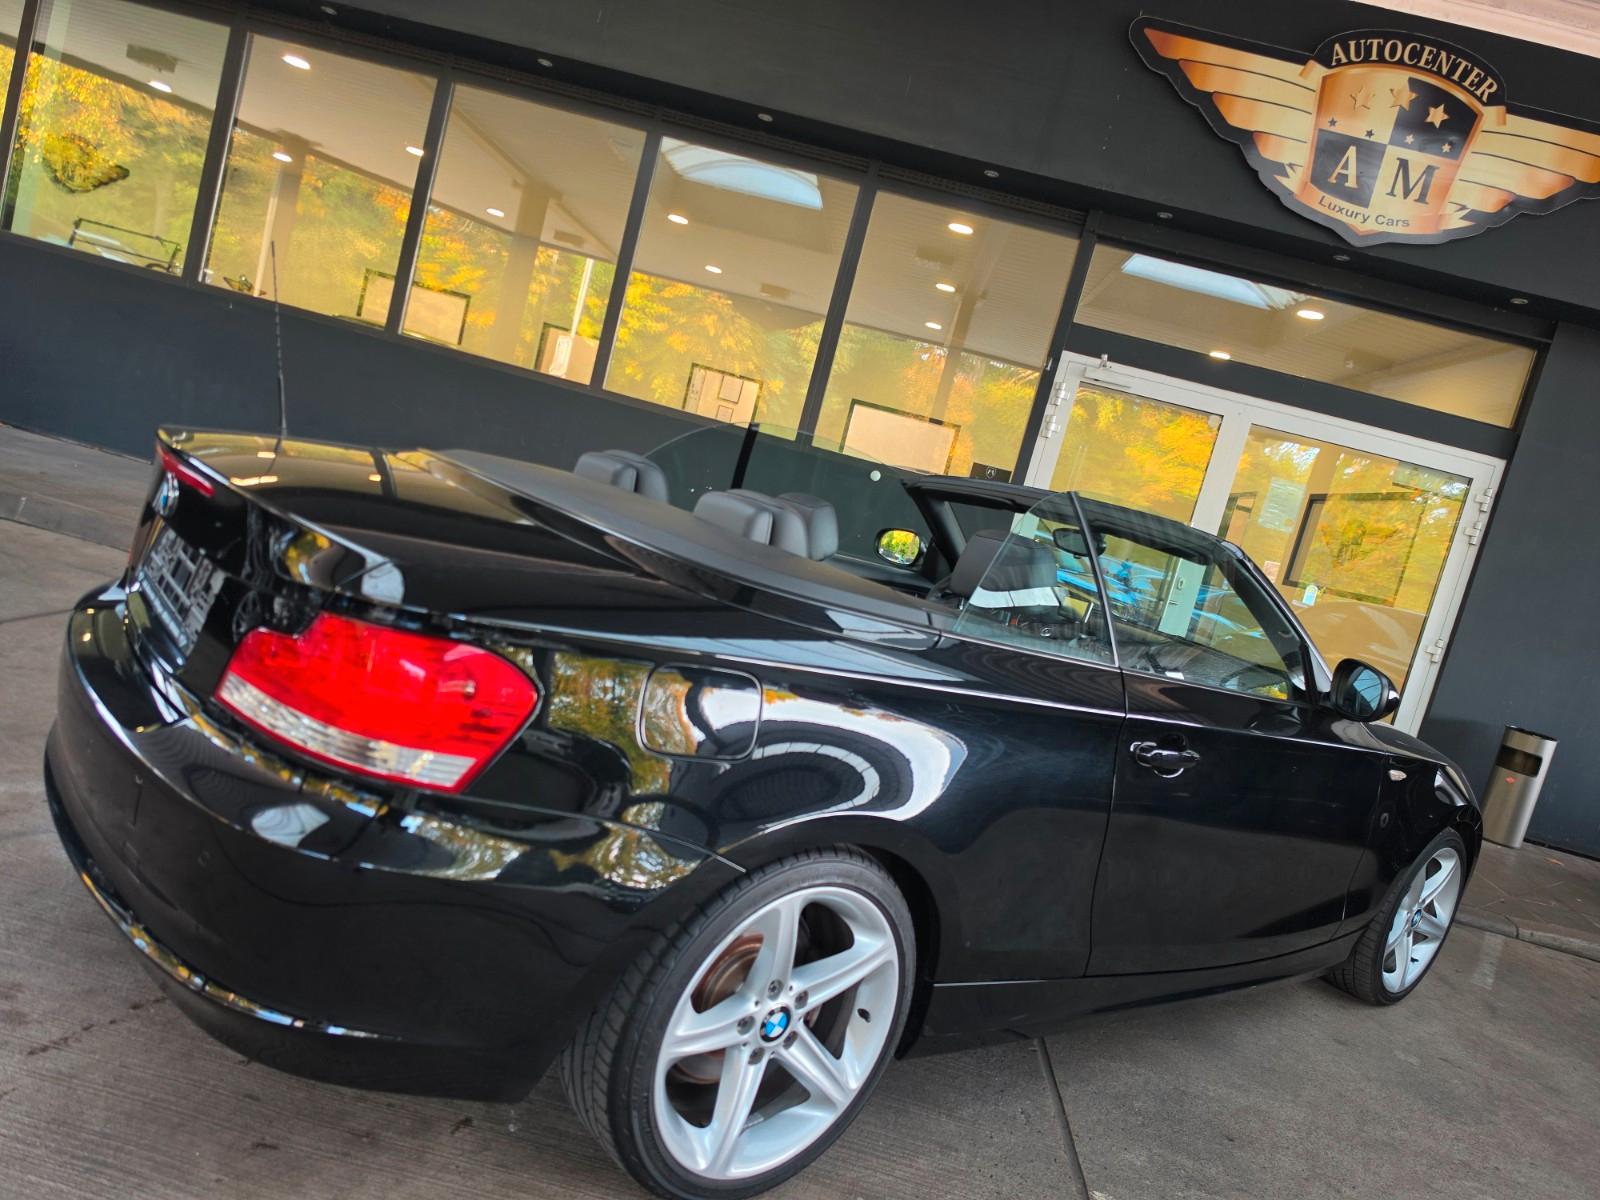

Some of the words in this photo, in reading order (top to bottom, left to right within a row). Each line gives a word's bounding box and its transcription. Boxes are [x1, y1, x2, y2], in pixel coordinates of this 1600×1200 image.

[1331, 39, 1498, 103] AUTOCENTER
[1327, 144, 1359, 189] A
[1385, 157, 1441, 205] M
[1318, 195, 1371, 224] Luxury
[1375, 214, 1410, 228] Cars
